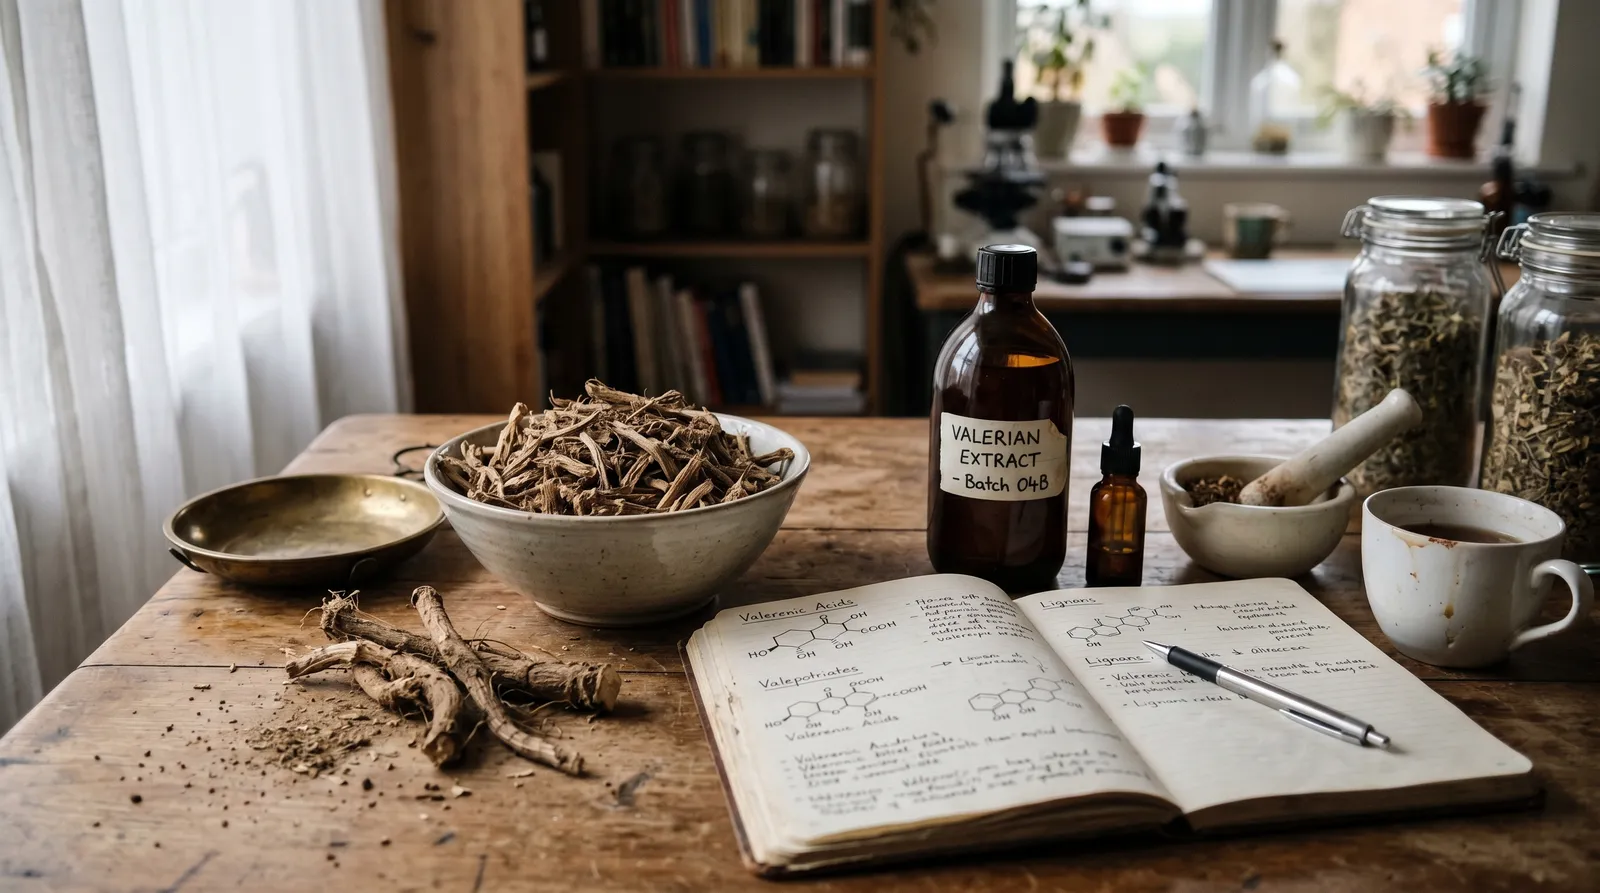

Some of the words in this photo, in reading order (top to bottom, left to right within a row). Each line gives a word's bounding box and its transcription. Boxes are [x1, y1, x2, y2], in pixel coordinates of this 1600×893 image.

[952, 424, 1040, 446] VALERIAN
[960, 449, 1041, 468] EXTRACT
[965, 473, 1009, 492] Batch
[1017, 474, 1049, 492] 04B
[1040, 596, 1097, 608] Lignans
[739, 606, 807, 622] Valerenic
[815, 598, 854, 611] Acids
[850, 611, 868, 620] OH
[835, 640, 854, 650] OH
[748, 650, 768, 659] HO
[796, 651, 816, 660] OH
[1085, 653, 1144, 667] Lignans
[759, 667, 859, 688] Valepotriates
[1112, 671, 1172, 682] Valerenic
[765, 720, 783, 729] HO
